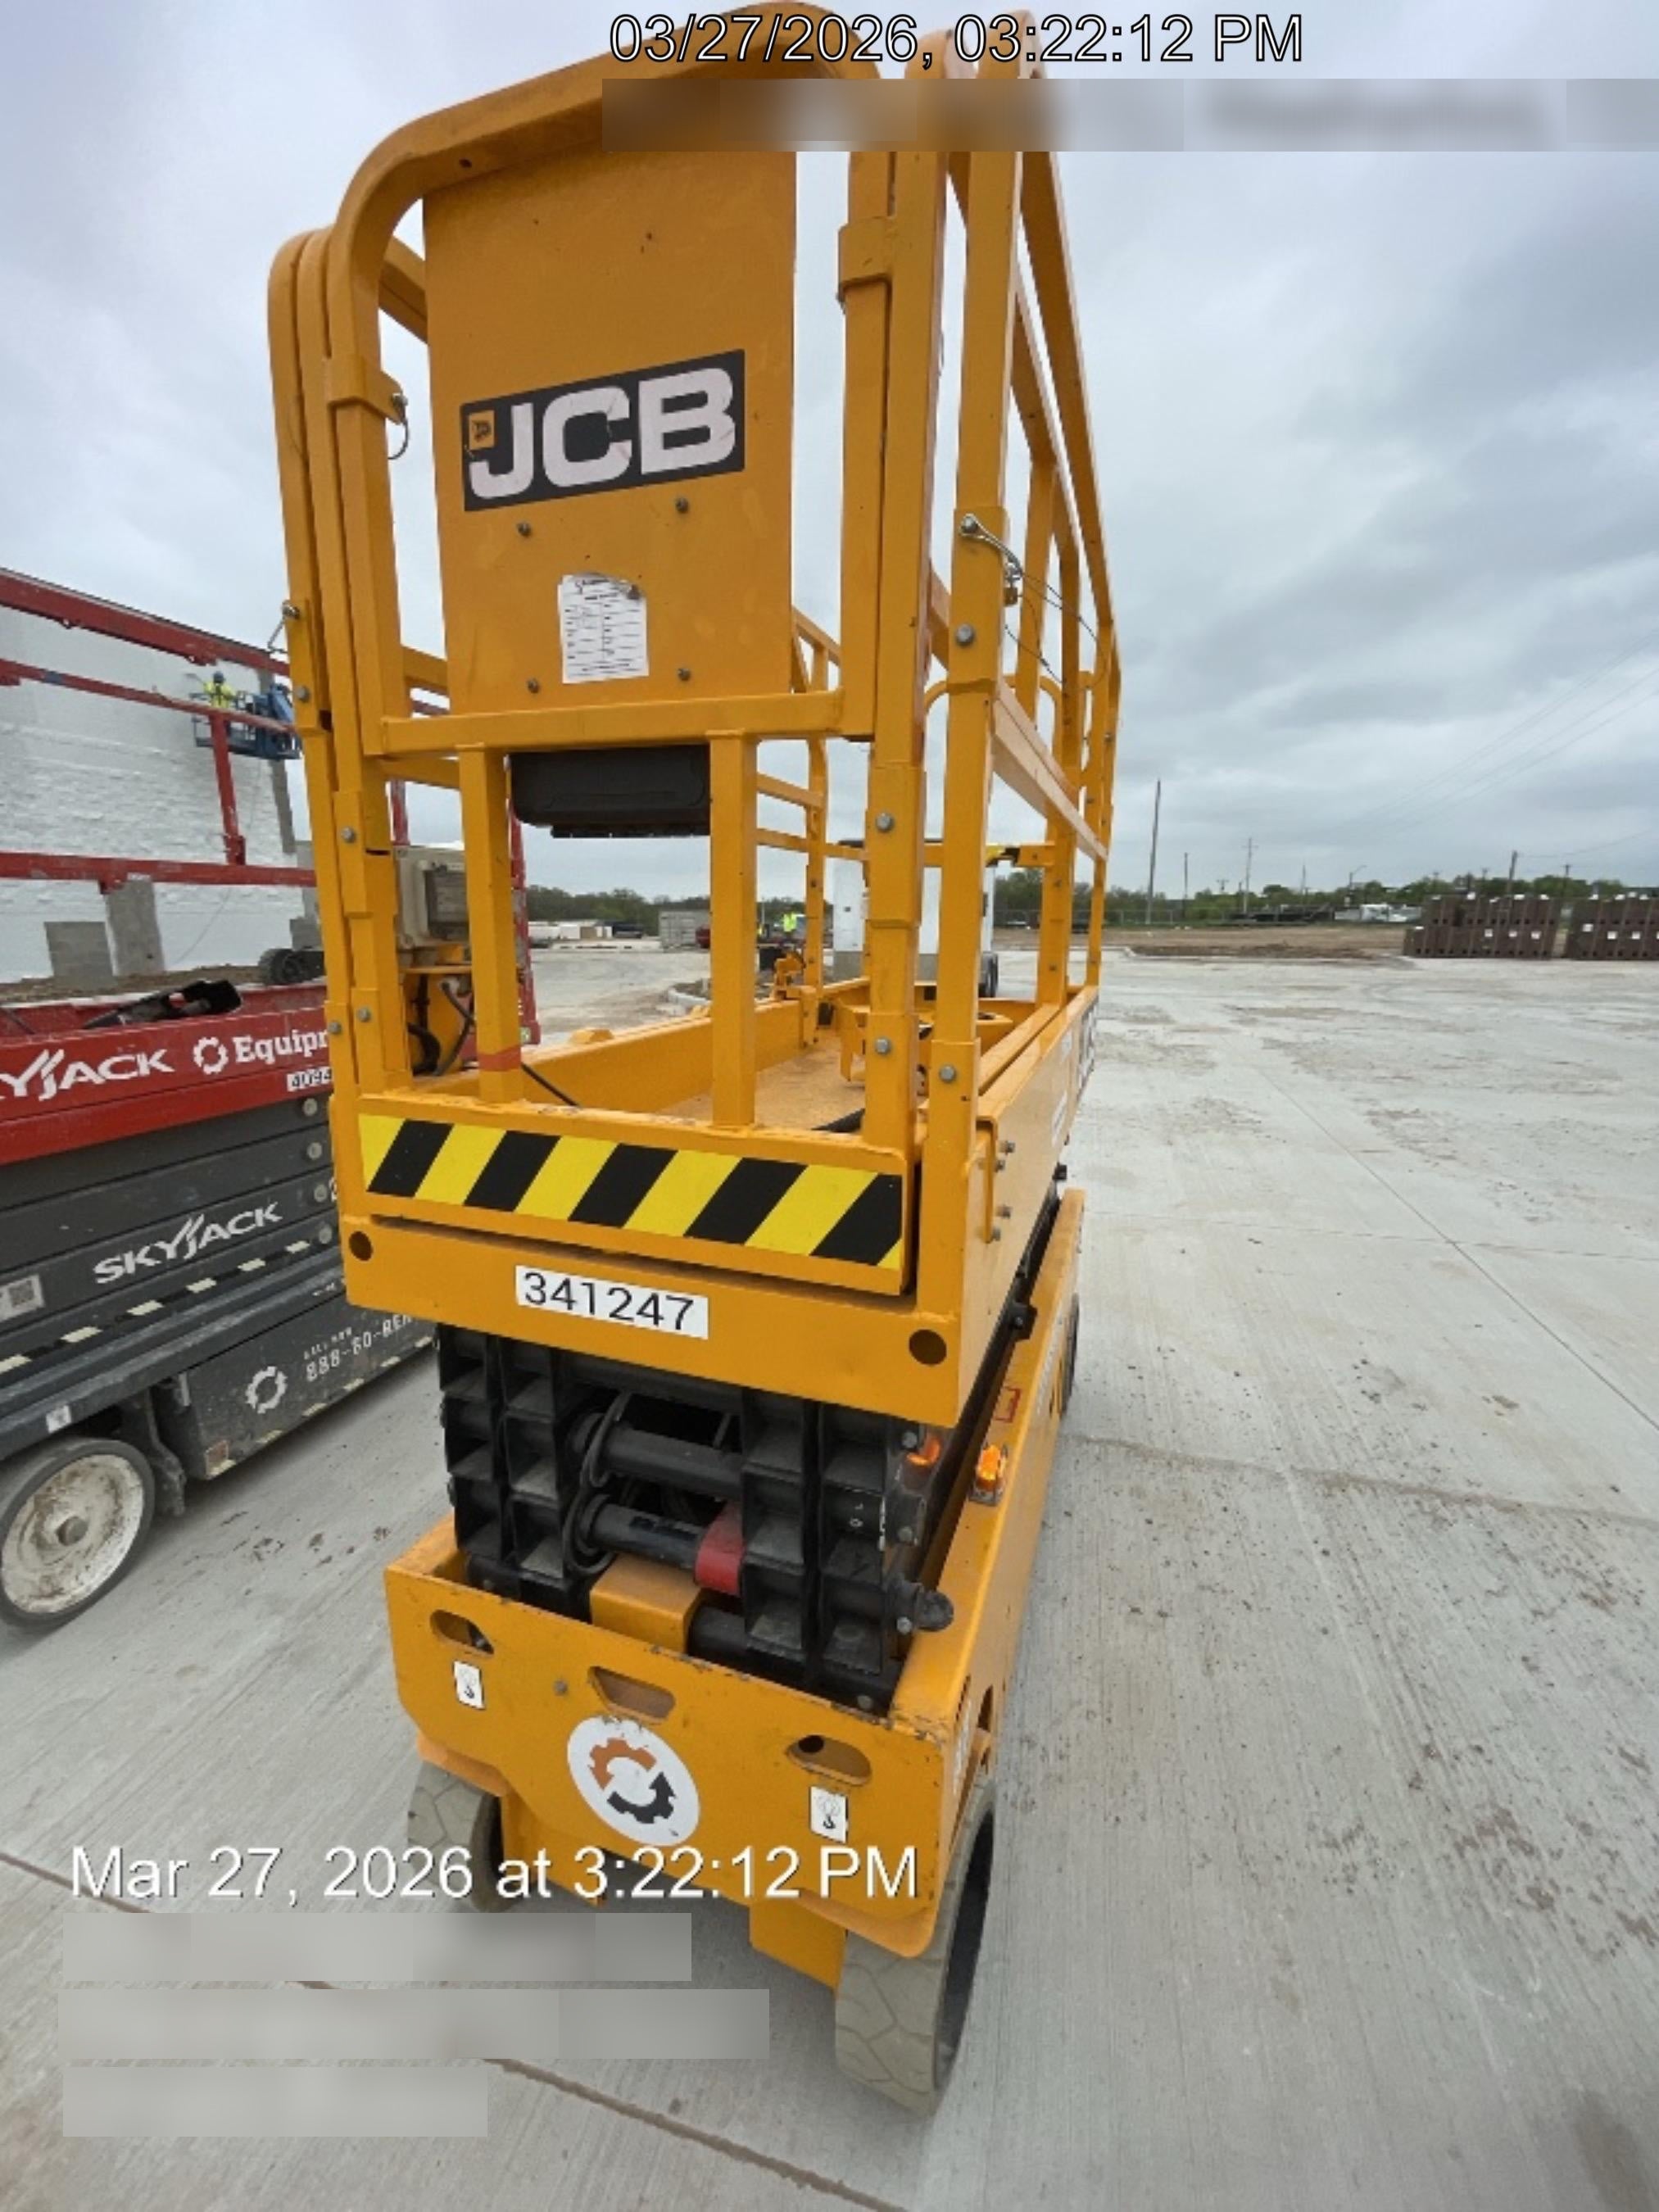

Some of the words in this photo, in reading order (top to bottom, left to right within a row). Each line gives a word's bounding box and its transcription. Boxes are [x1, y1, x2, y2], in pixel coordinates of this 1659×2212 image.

[469, 368, 736, 499] JCB
[0, 1049, 175, 1102] YJACK
[93, 1201, 283, 1284] SKYJACK
[524, 1272, 694, 1330] 341247
